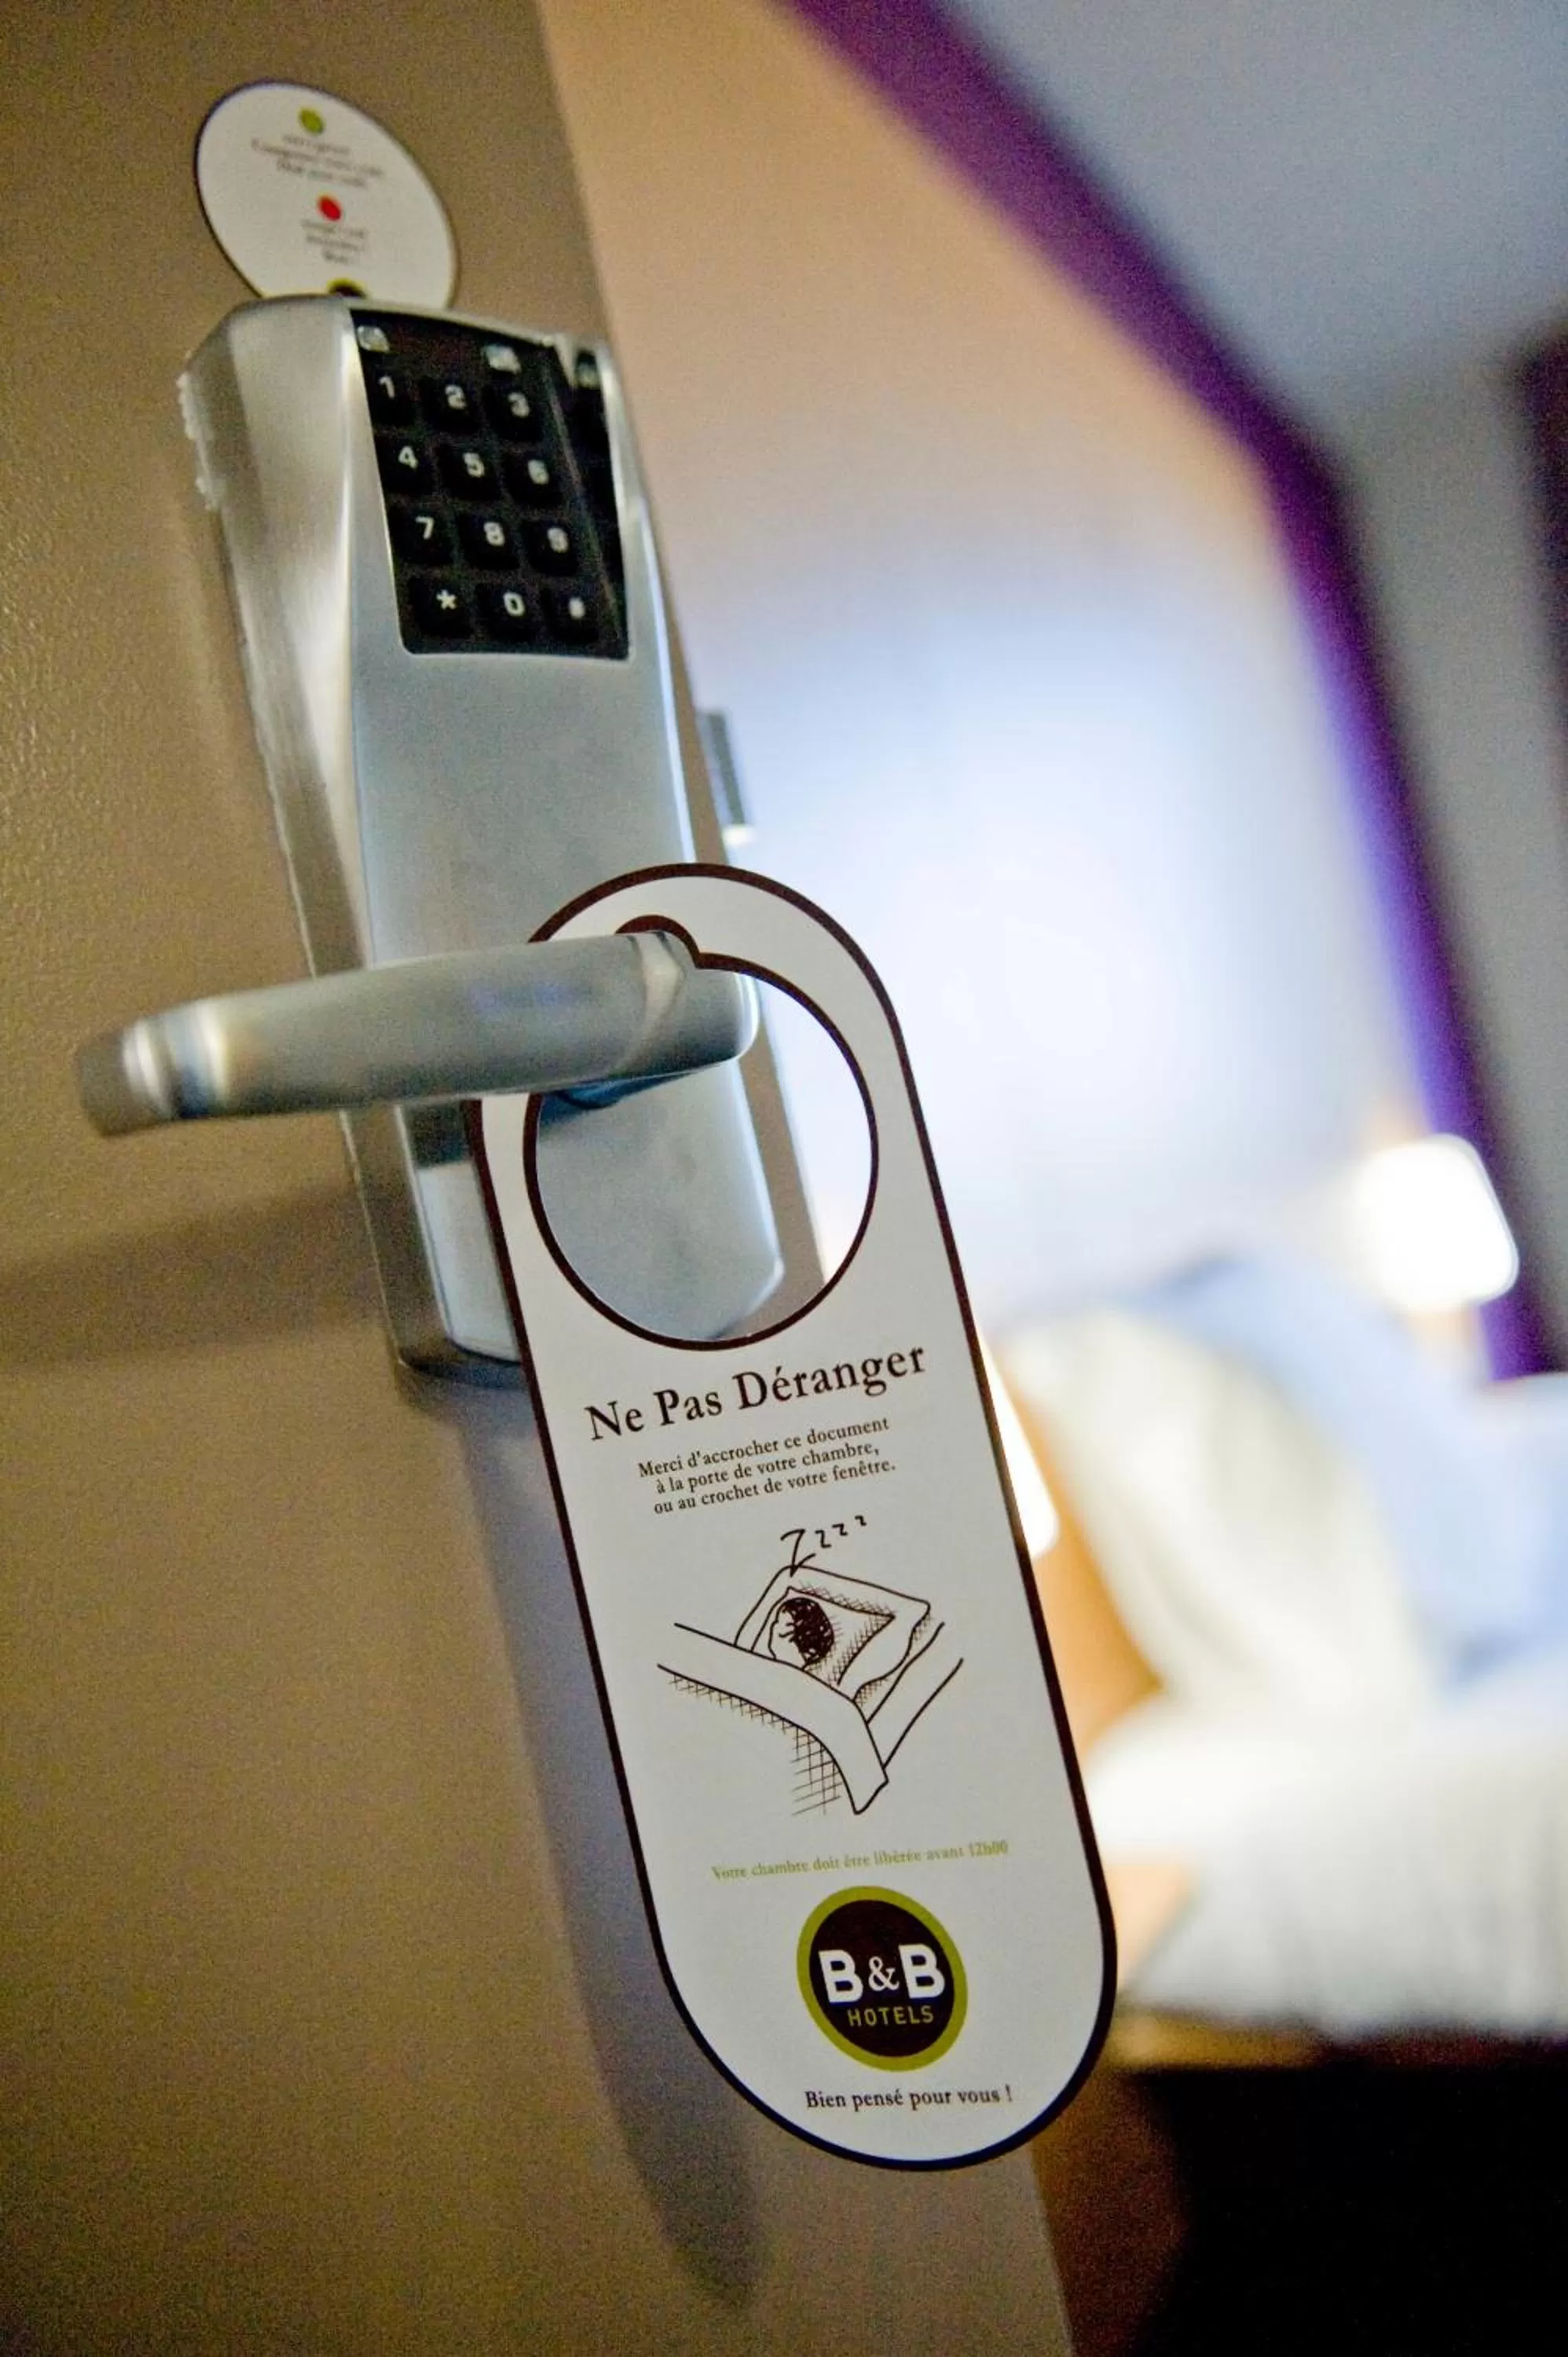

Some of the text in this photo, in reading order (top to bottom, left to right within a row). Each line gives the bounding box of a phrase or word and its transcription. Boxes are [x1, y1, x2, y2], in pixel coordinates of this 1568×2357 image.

[379, 375, 529, 417] 1 2 3
[398, 446, 418, 468] 4
[463, 453, 485, 477] 5
[416, 517, 434, 540] 7
[484, 522, 505, 546] 8
[503, 591, 526, 617] 0
[584, 1347, 925, 1440] Ne Pas Déranger
[638, 1417, 889, 1477] Merci d'accrocher ce document
[654, 1461, 896, 1514] ou au crochet de votre fenêtre.
[656, 1442, 879, 1494] à la porte de votre chambre,
[711, 1866, 746, 1879] Votre
[751, 1860, 808, 1875] chambre
[812, 1856, 840, 1871] doit
[844, 1853, 870, 1868] être
[927, 1847, 965, 1860] avant
[969, 1840, 1009, 1857] 12h00
[818, 1943, 946, 2004] B&B
[848, 2005, 934, 2027] HOTELS
[804, 2091, 846, 2108] Bien
[852, 2088, 904, 2112] pensé
[909, 2091, 952, 2110] pour
[957, 2088, 1001, 2104] vous
